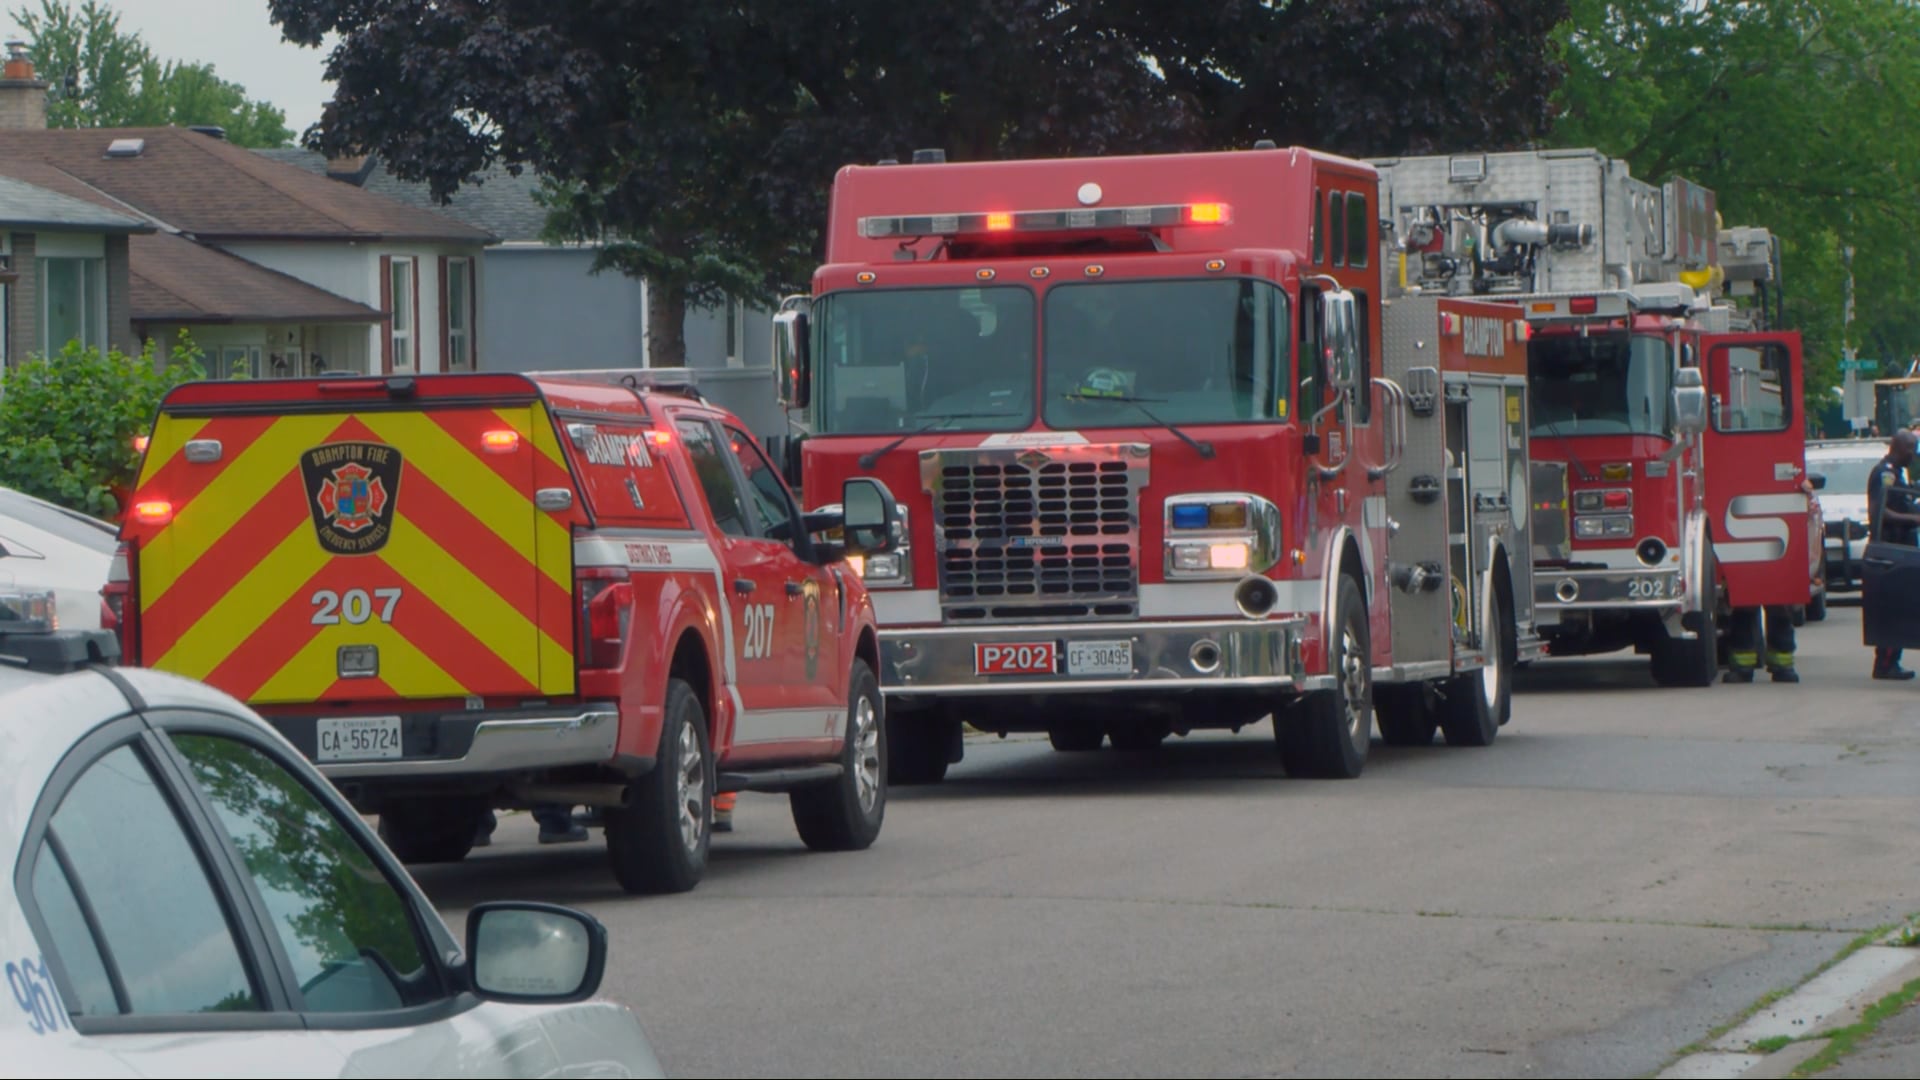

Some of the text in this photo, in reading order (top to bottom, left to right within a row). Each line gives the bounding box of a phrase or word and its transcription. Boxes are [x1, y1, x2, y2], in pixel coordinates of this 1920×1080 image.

[1463, 315, 1504, 357] BRAMPTON
[312, 445, 390, 467] BRAMPTON FIRE
[320, 523, 387, 550] EMERGENCY SERVICES
[624, 544, 672, 565] DISTRICT CHIEF
[1628, 580, 1664, 597] 202
[311, 588, 402, 625] 207
[743, 603, 775, 659] 207
[983, 646, 1048, 669] P202
